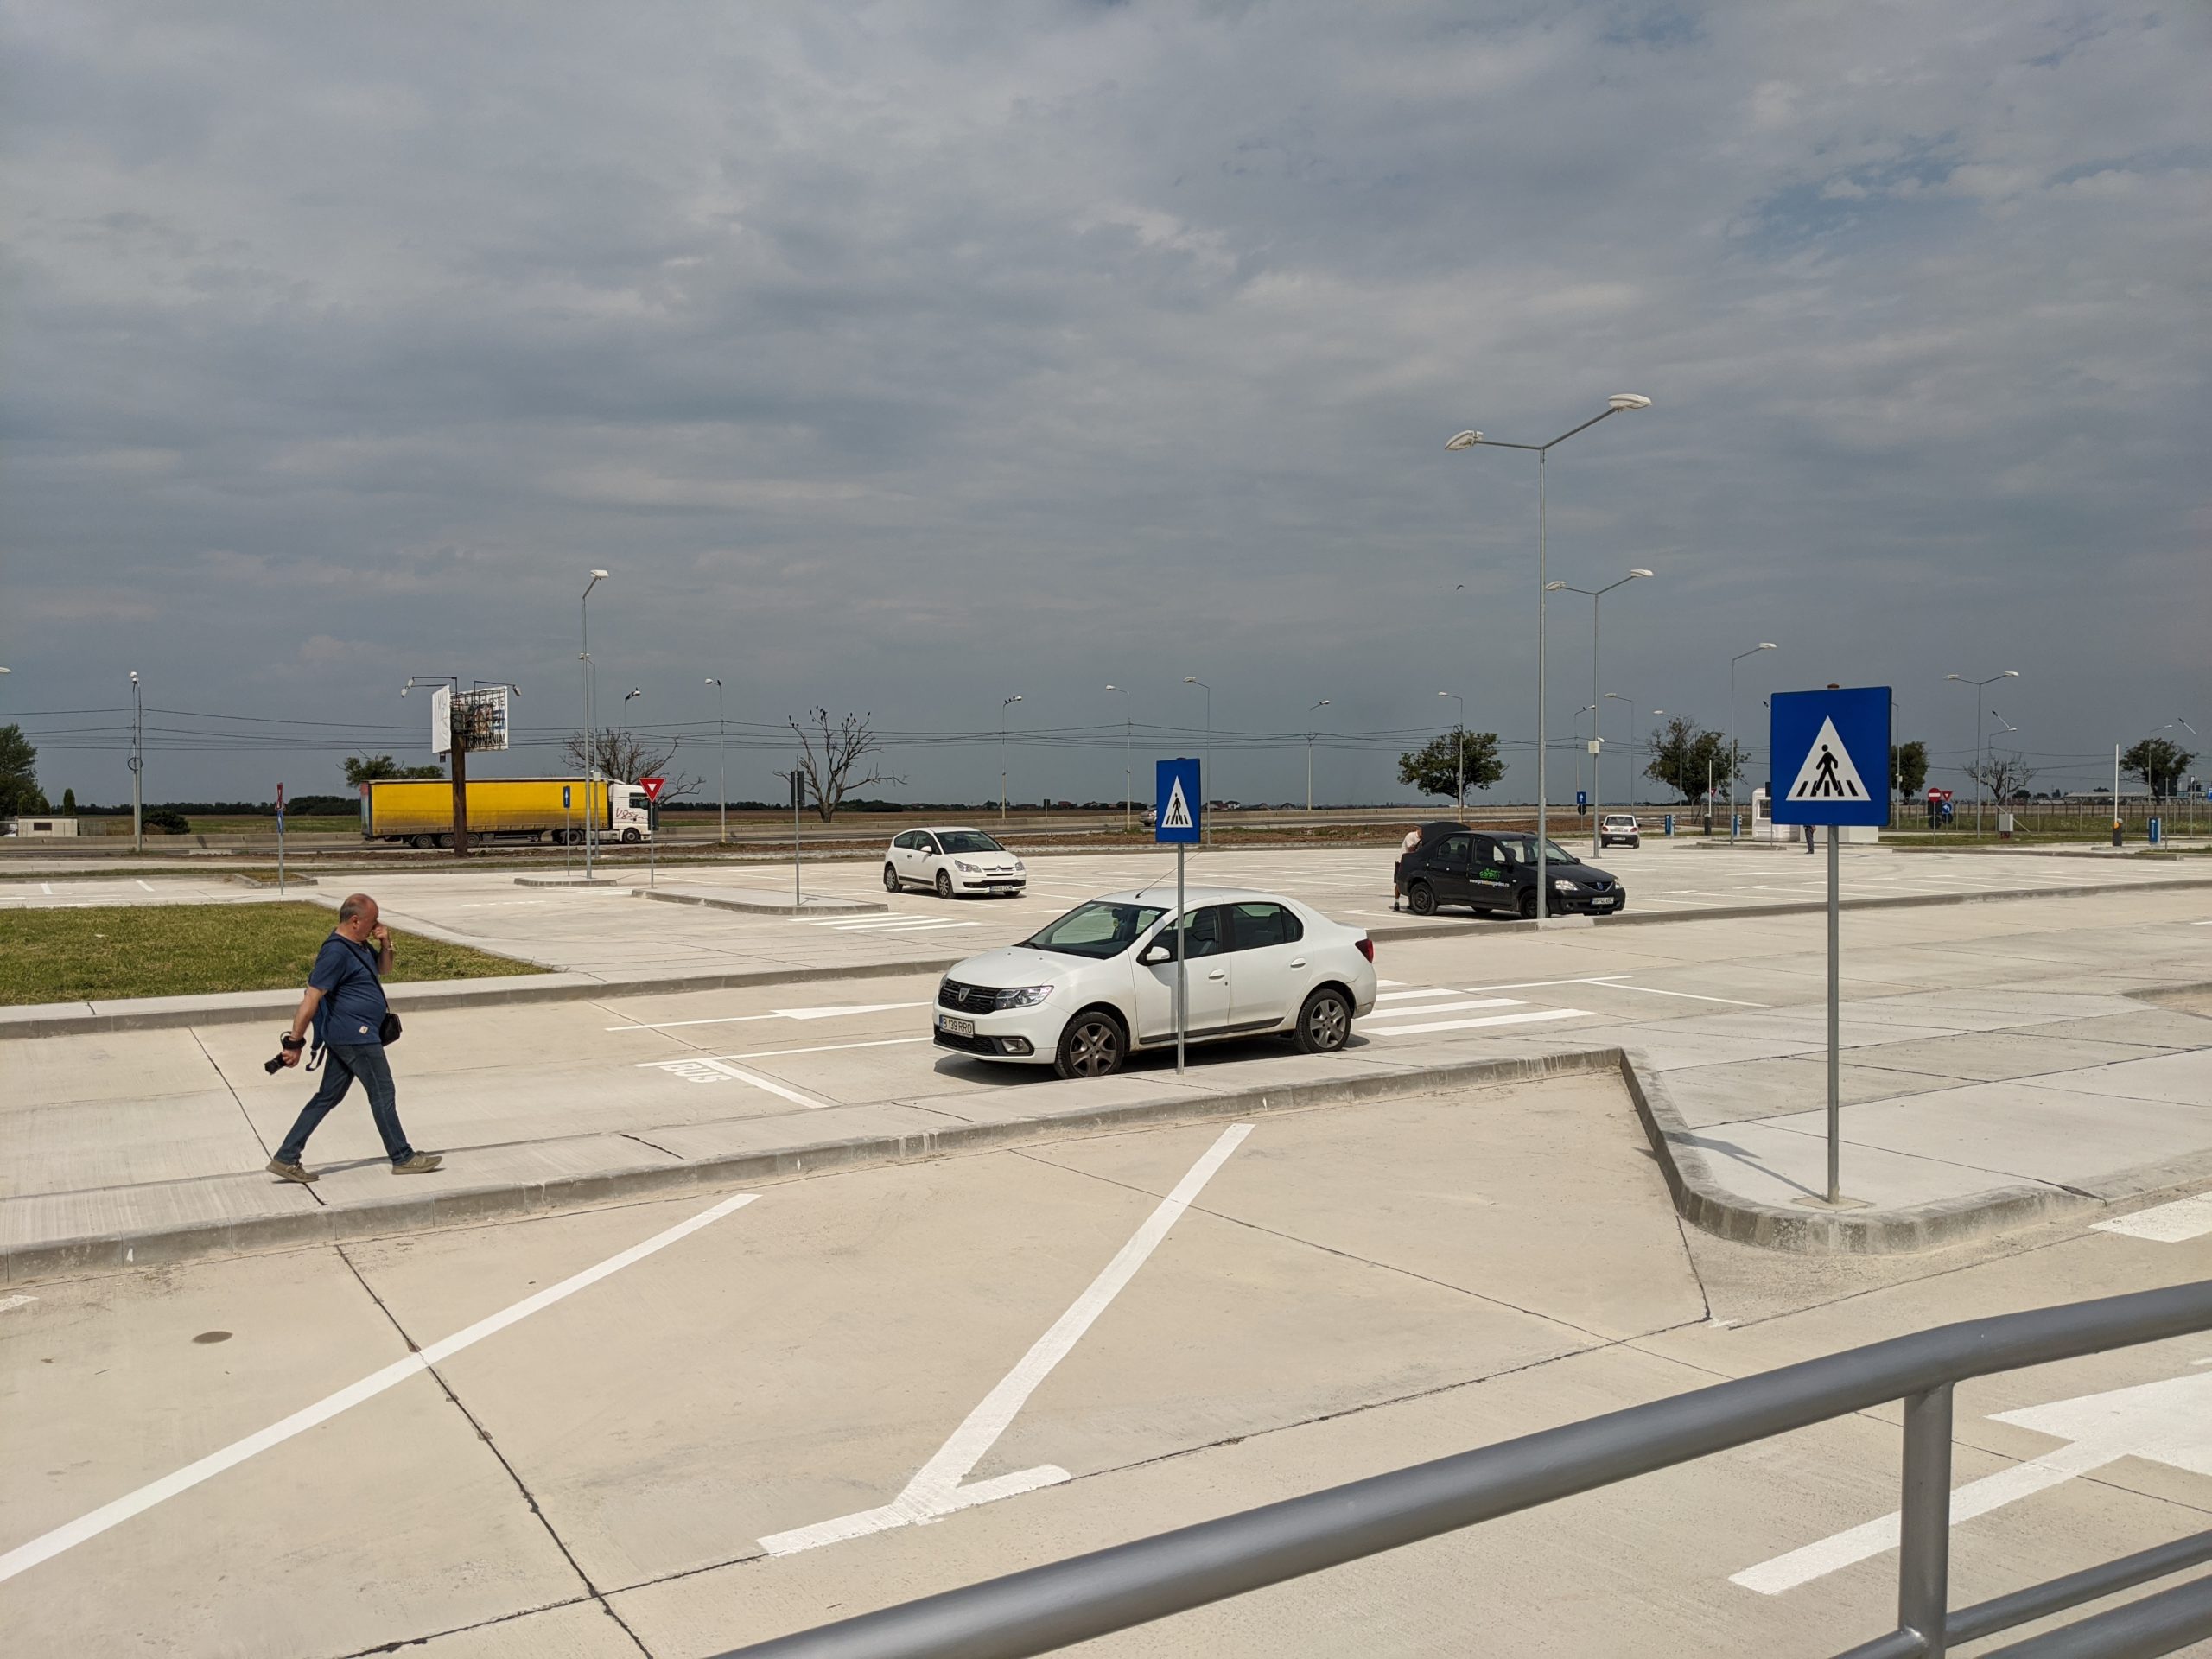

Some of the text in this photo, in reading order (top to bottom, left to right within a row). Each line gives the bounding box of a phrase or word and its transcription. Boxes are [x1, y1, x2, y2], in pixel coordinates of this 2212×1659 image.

[943, 1018, 972, 1034] B 139 RRO
[658, 1062, 732, 1083] BUS
